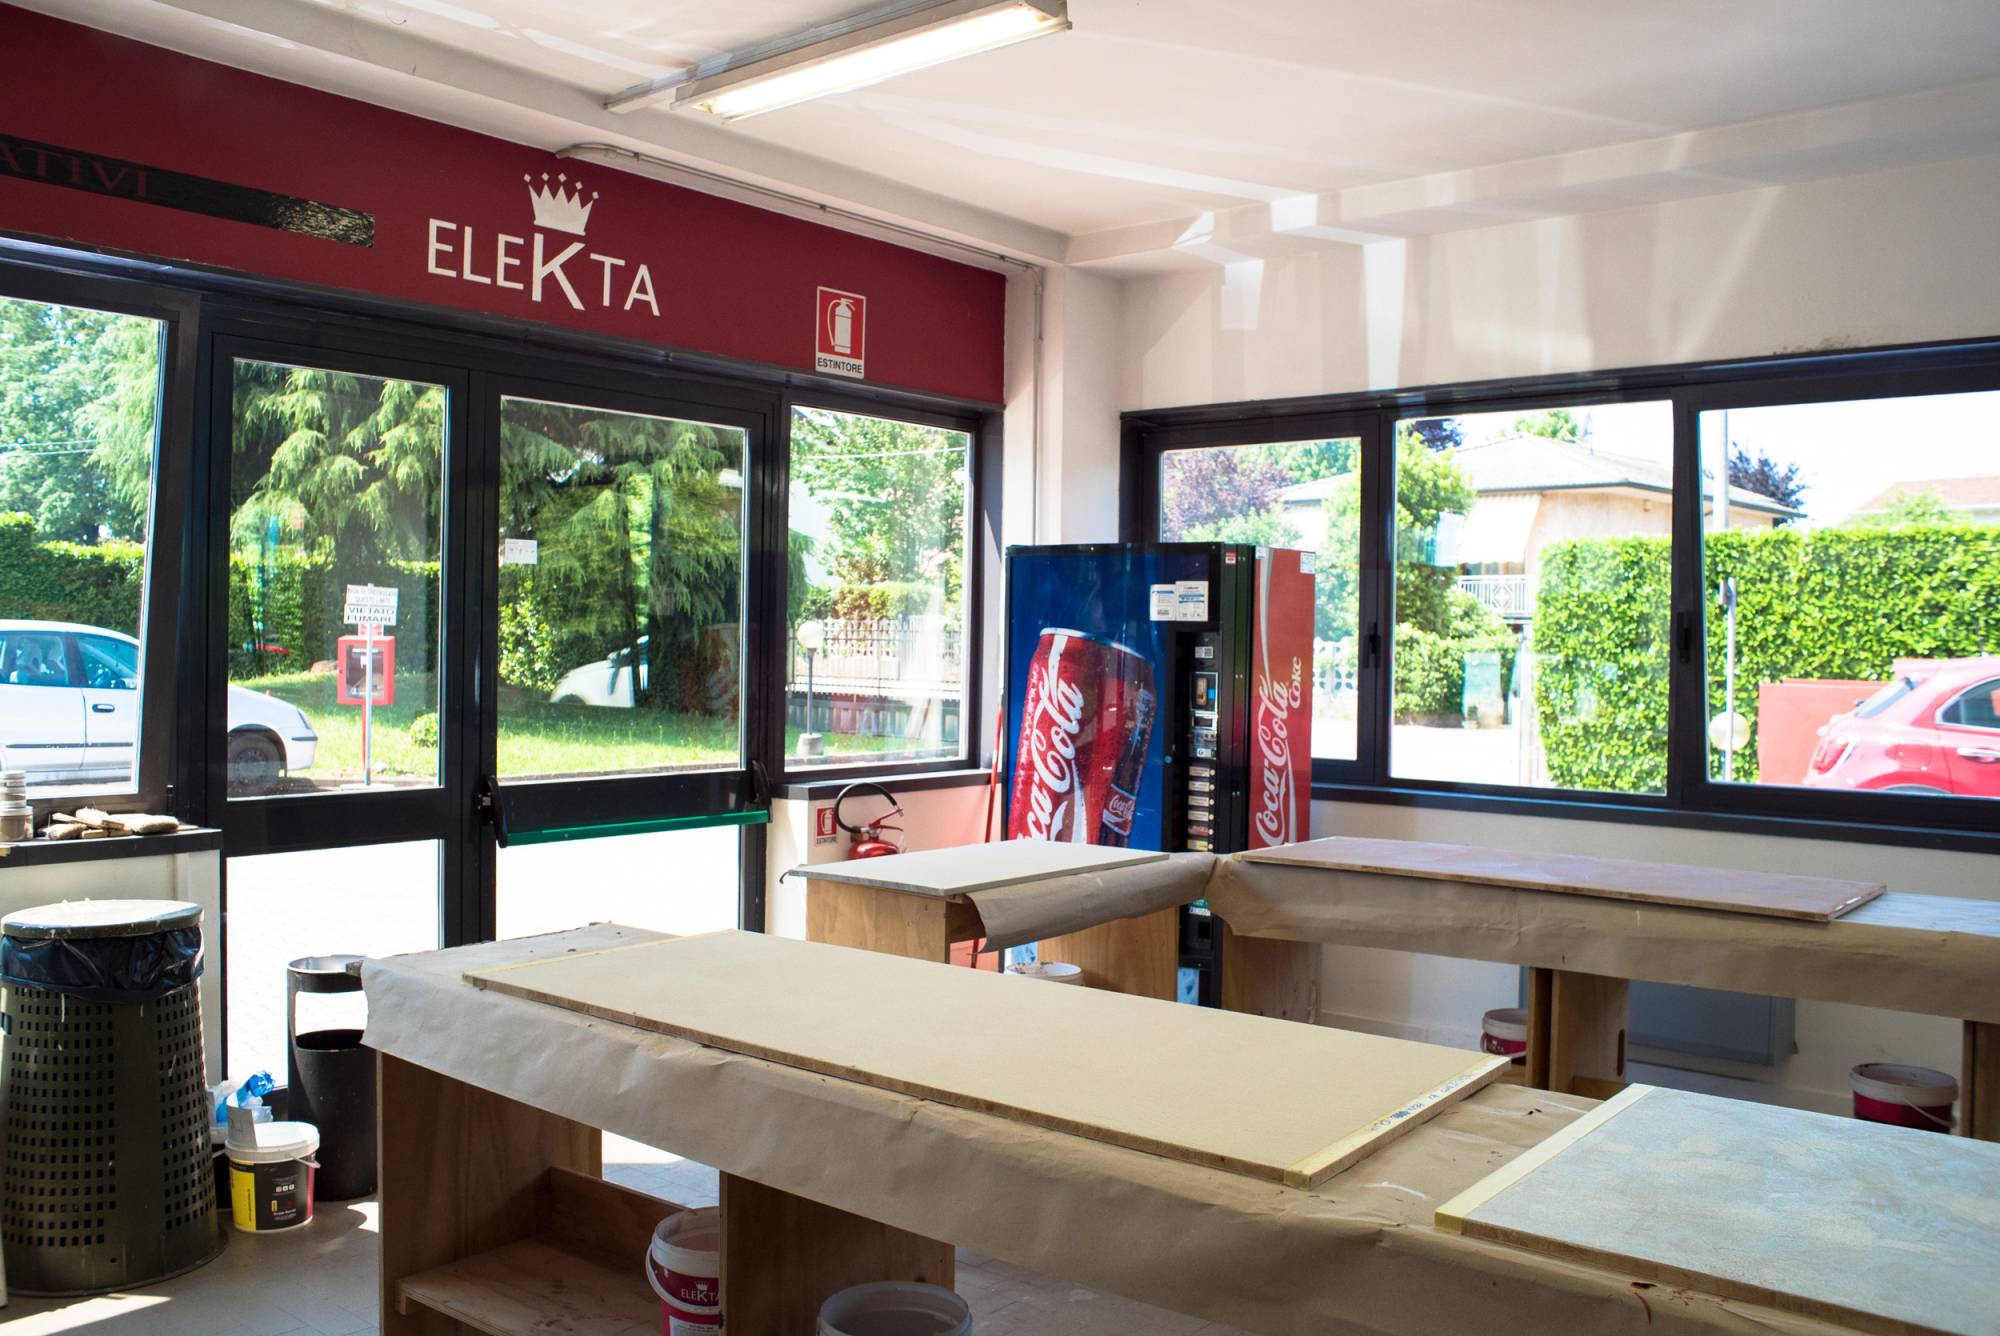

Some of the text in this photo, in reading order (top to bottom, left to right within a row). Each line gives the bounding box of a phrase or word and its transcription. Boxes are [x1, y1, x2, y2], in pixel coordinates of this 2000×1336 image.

[427, 217, 661, 317] ELEKTA
[816, 356, 863, 374] ESTINTORE
[1288, 656, 1302, 709] Coke
[1255, 674, 1290, 848] Coca-Cola
